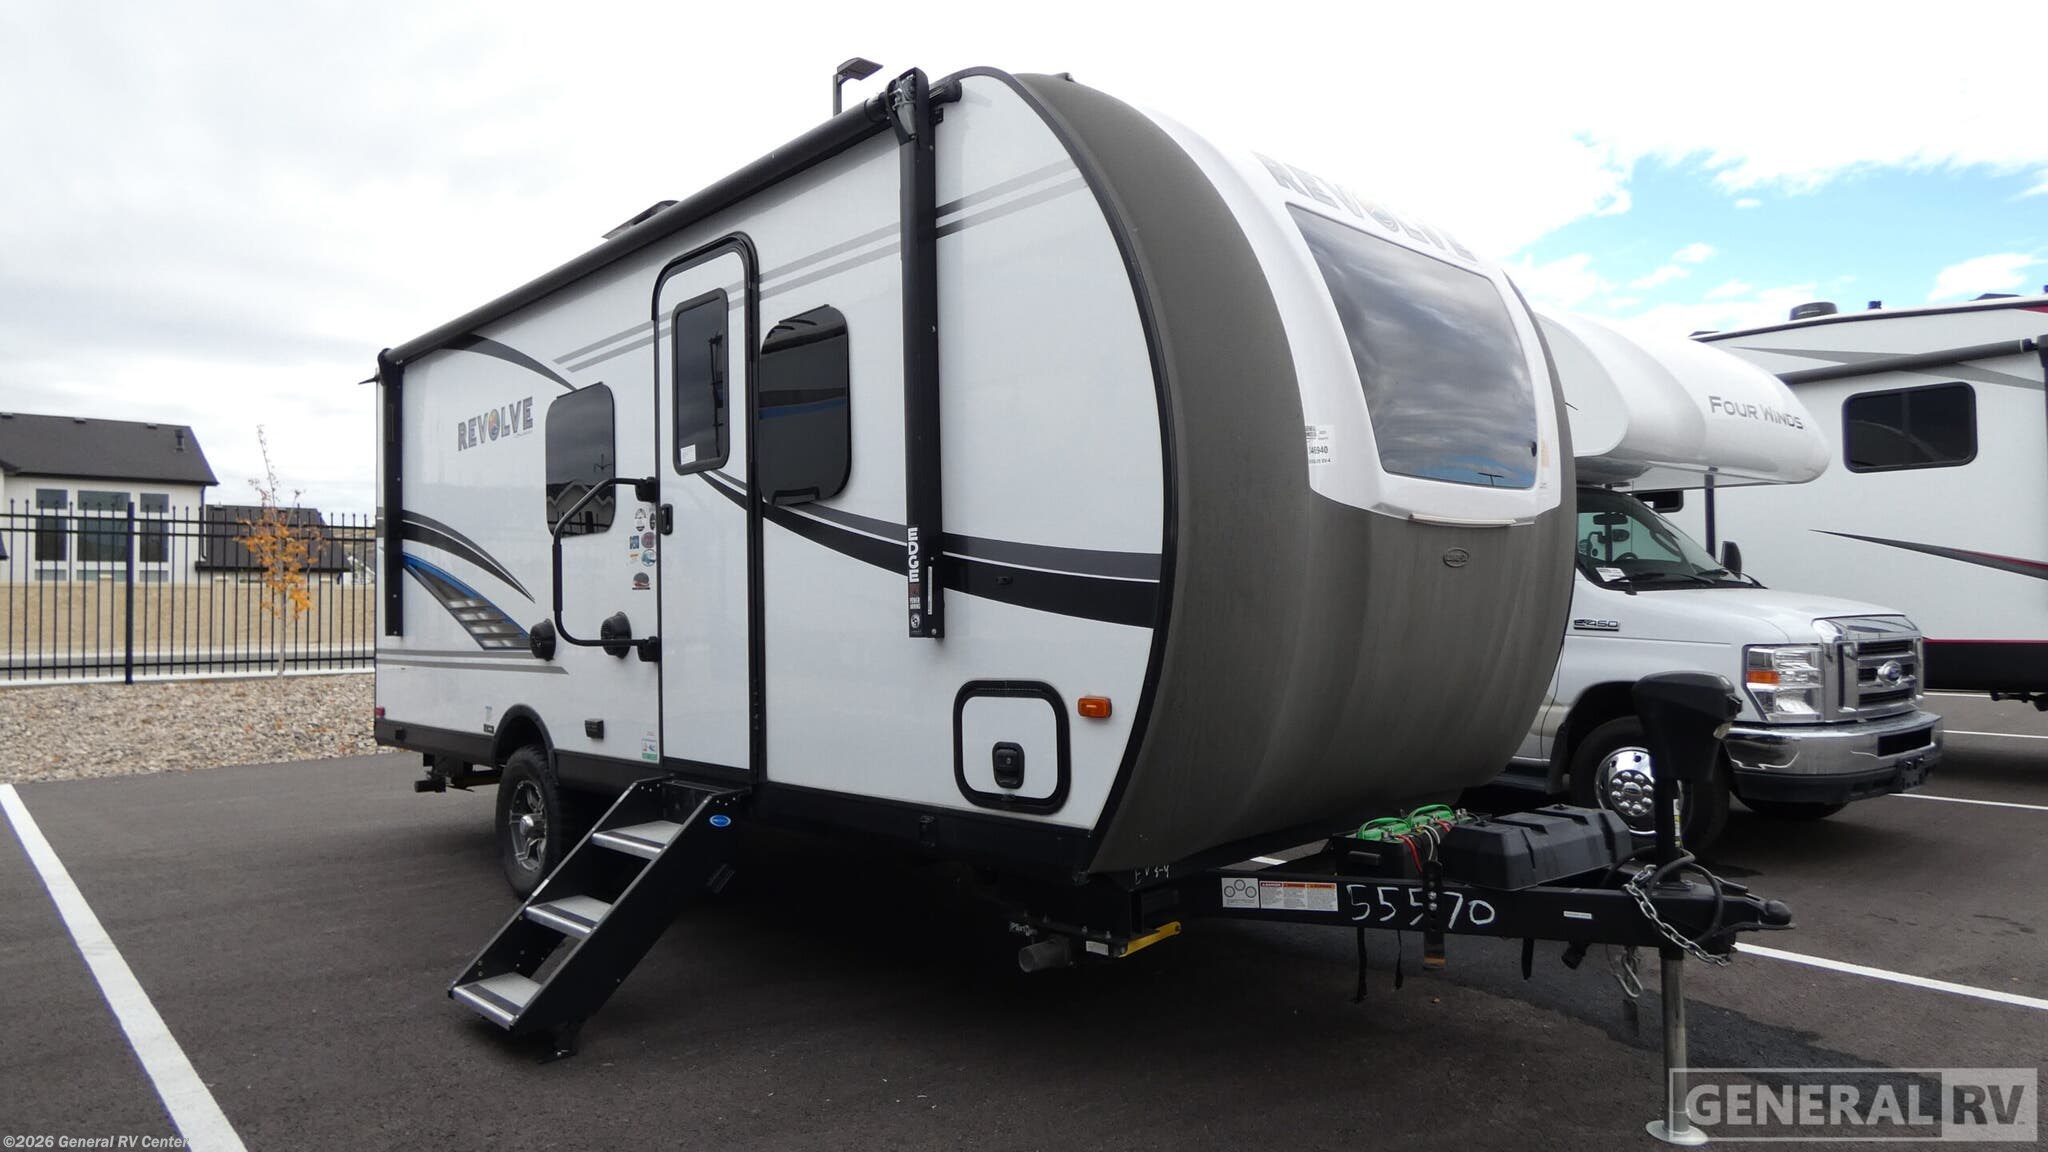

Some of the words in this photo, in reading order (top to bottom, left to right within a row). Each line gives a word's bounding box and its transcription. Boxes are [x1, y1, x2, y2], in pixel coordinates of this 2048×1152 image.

[1250, 150, 1479, 264] REVOLVE
[457, 395, 533, 451] REVOLVE
[1708, 395, 1759, 420] FOUR
[907, 526, 920, 583] EDGE
[1346, 884, 1496, 930] 55570
